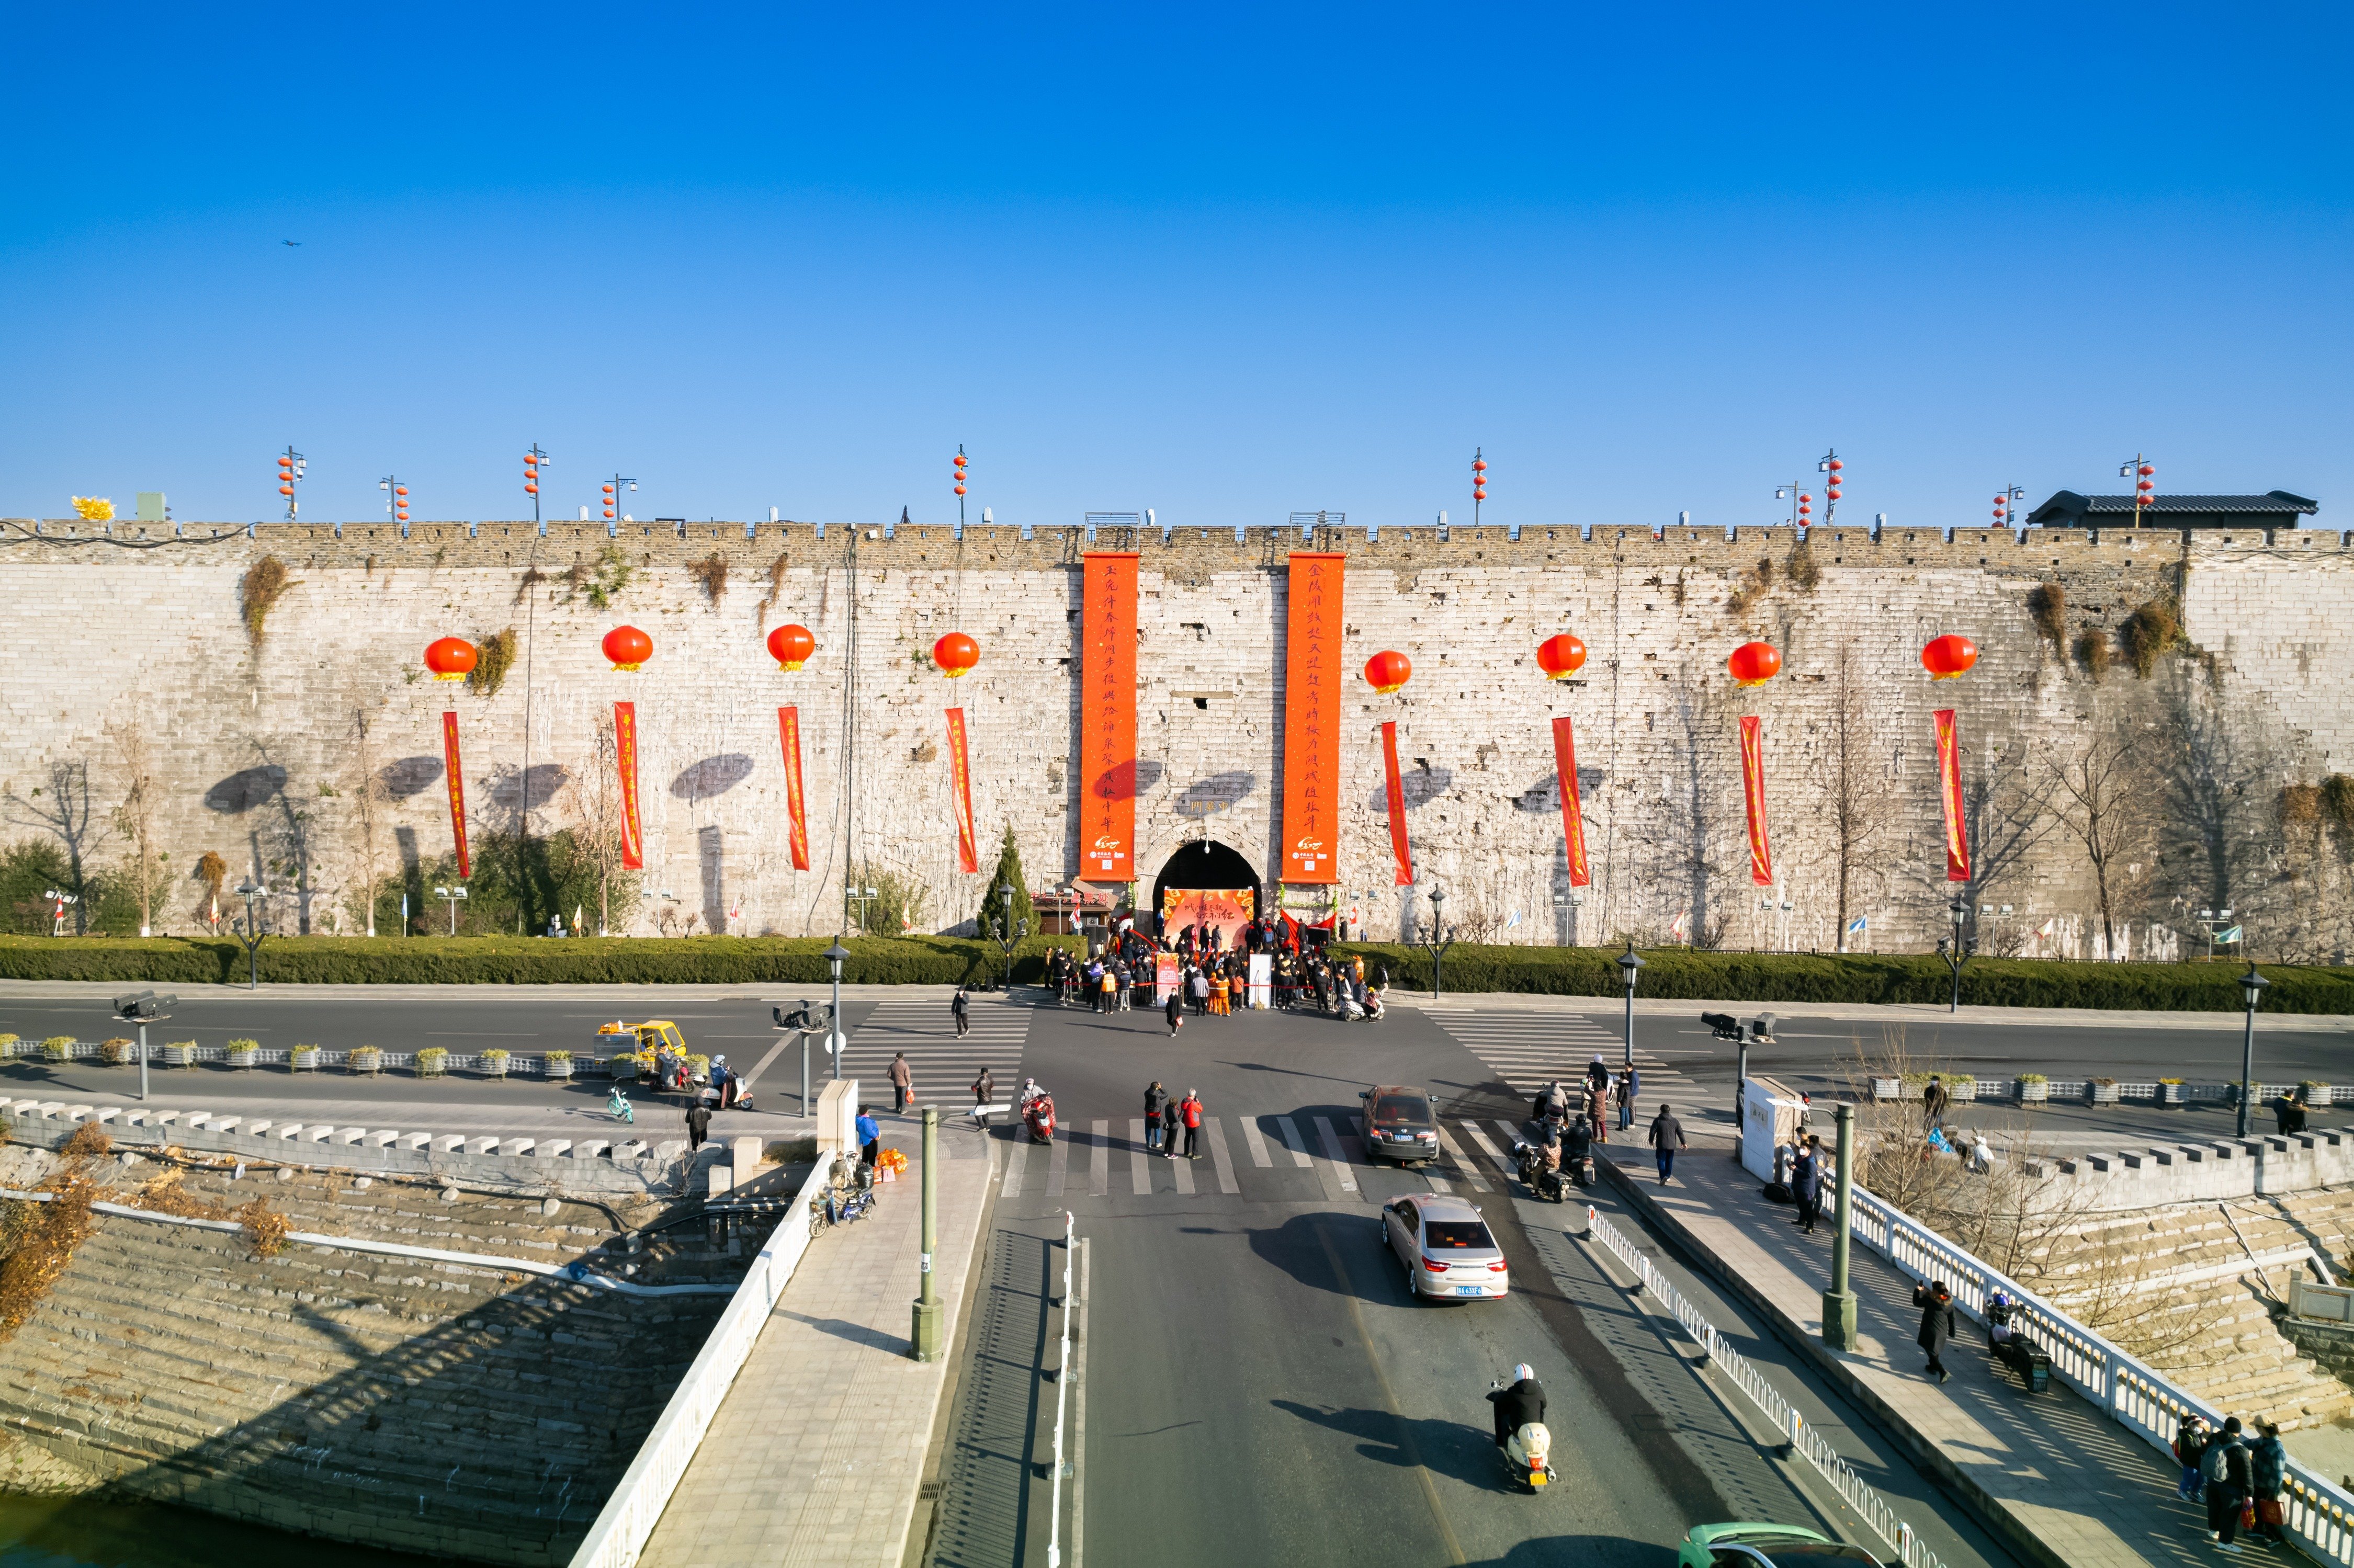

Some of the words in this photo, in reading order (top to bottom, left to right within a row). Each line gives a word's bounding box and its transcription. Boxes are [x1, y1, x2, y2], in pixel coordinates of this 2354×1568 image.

[1194, 908, 1235, 921] 南京开门红
